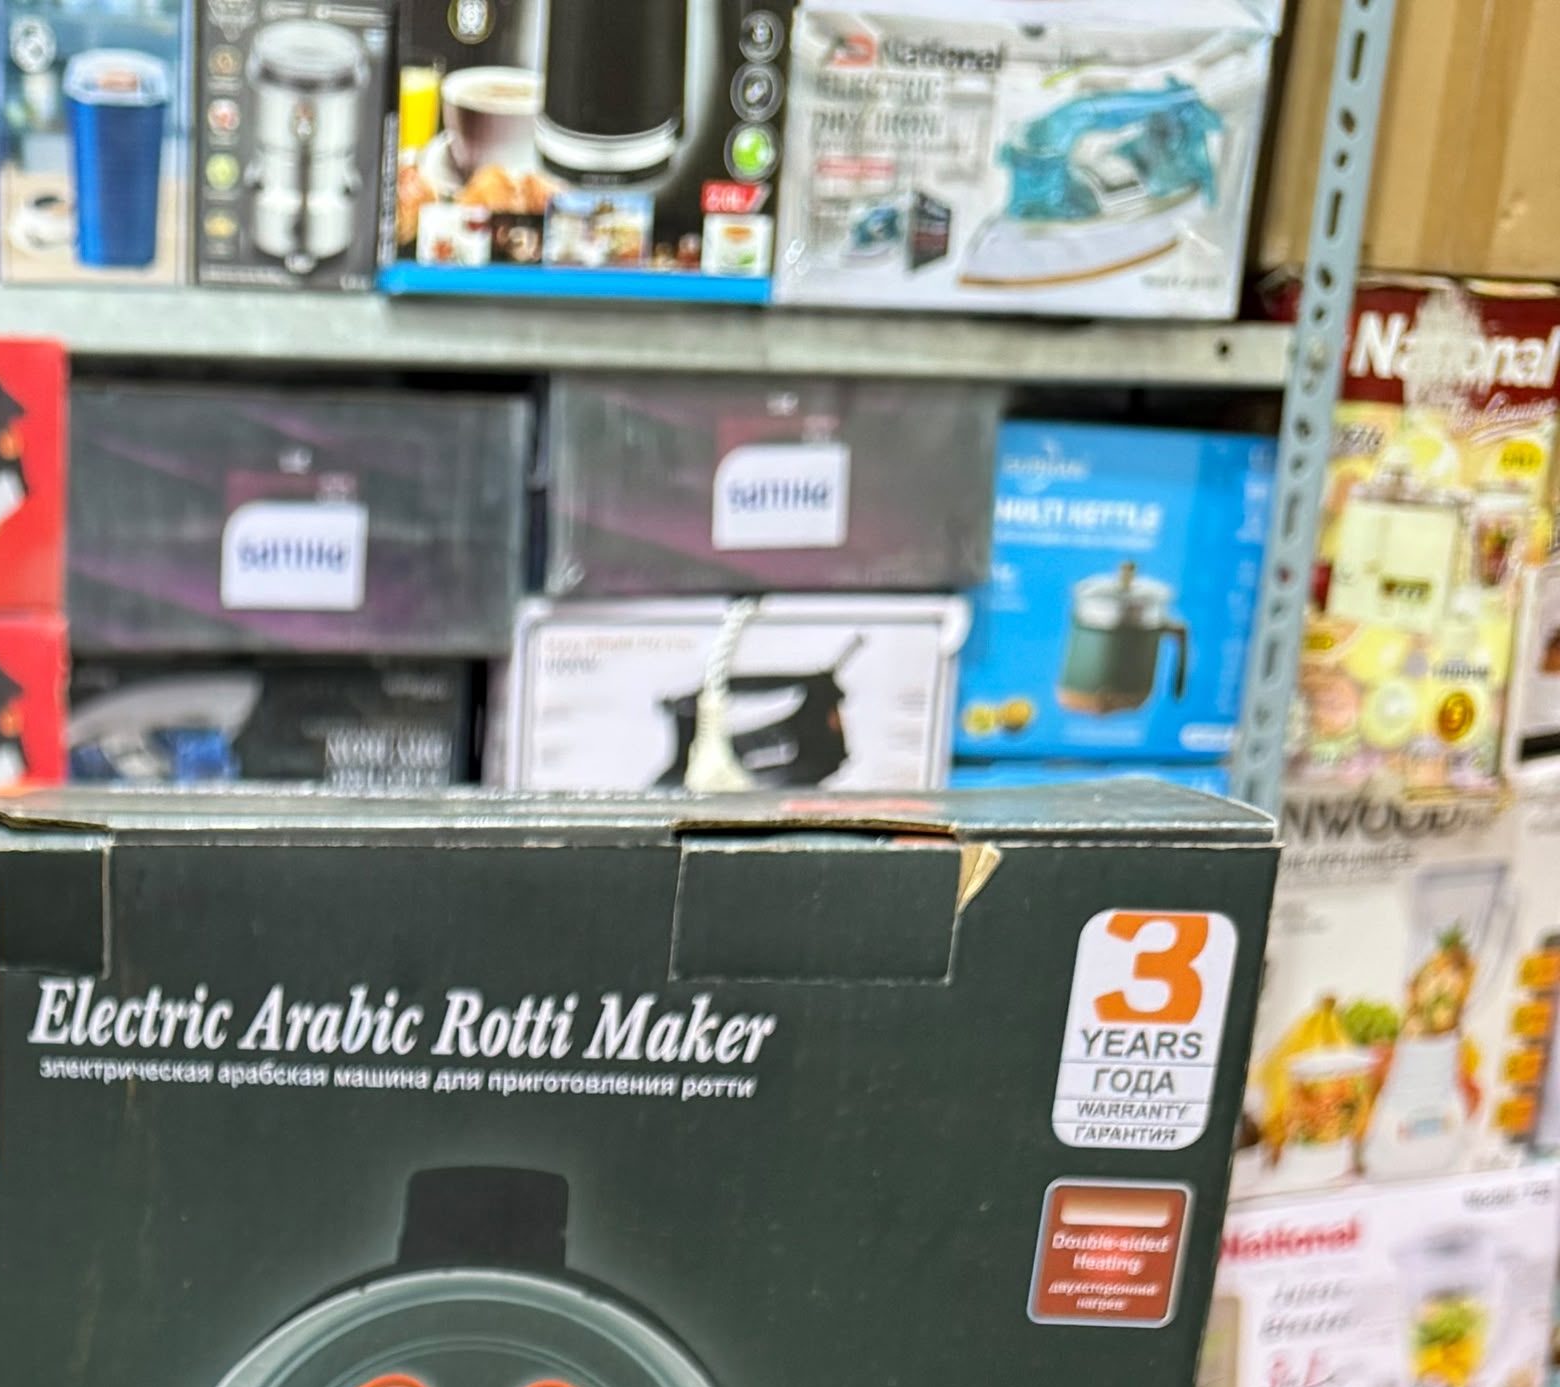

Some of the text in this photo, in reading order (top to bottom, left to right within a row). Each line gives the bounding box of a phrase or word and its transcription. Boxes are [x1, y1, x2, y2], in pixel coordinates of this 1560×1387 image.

[1349, 308, 1559, 391] Naonal
[1093, 912, 1209, 1026] 3
[27, 975, 778, 1065] Electric Arabic Rotti Maker
[1081, 1028, 1203, 1059] YEARS
[40, 1056, 759, 1101] электрическая арабская машина для приготовления ротти
[1093, 1067, 1176, 1098] ГОДА
[1077, 1101, 1190, 1121] WARRANTY
[1074, 1125, 1178, 1143] ГАРАНТИЯ
[1051, 1230, 1173, 1254] Double-sided
[1072, 1251, 1146, 1276] Heating
